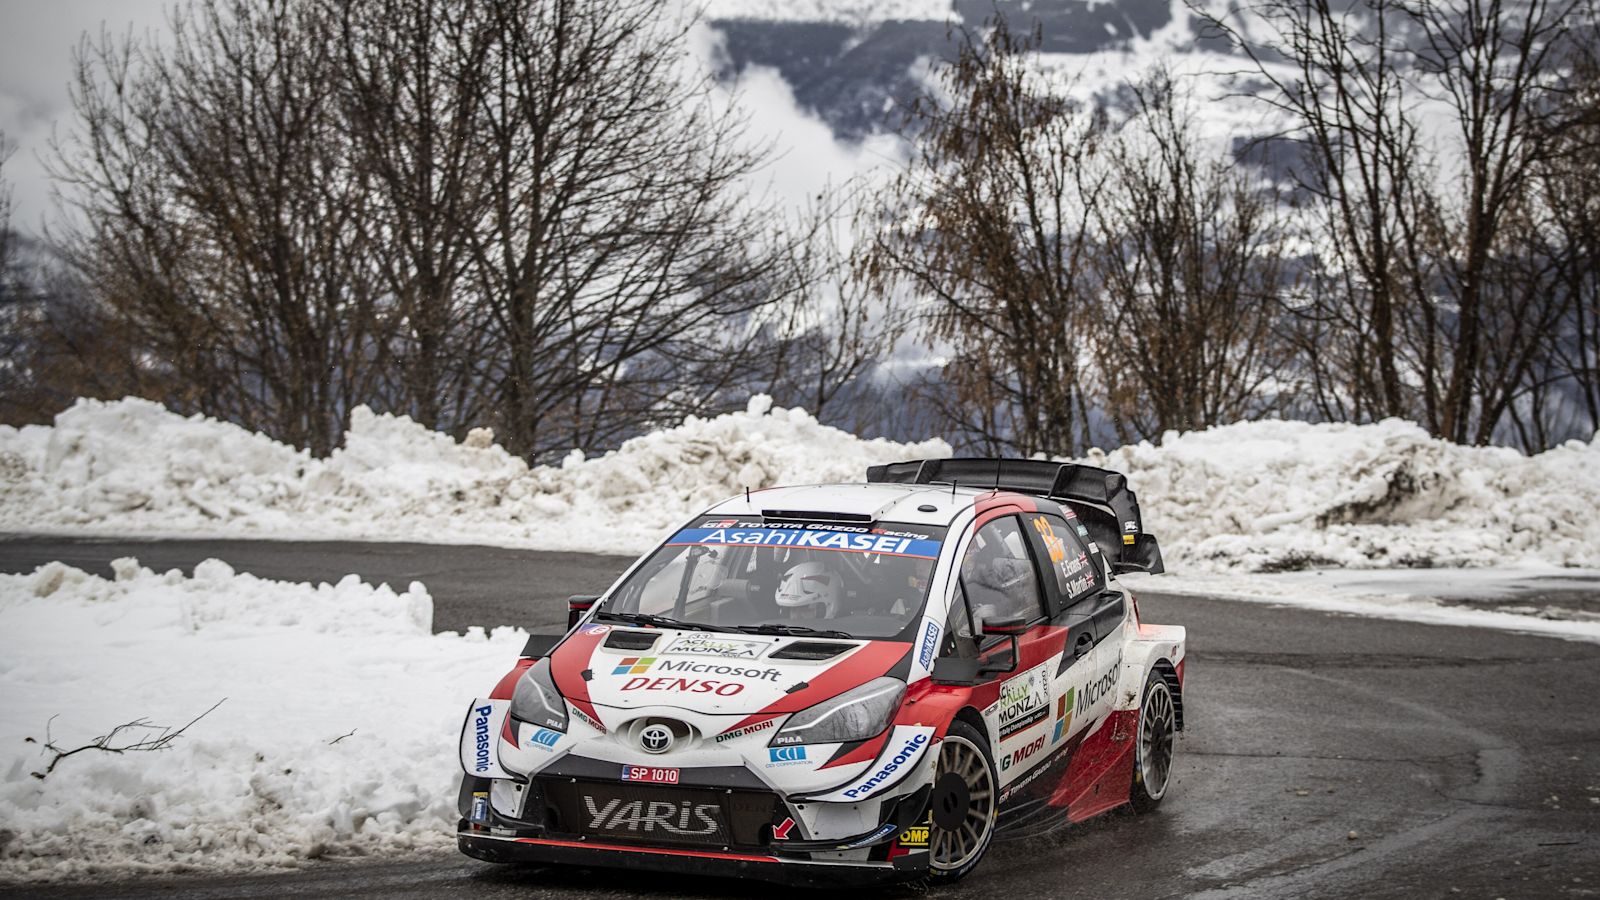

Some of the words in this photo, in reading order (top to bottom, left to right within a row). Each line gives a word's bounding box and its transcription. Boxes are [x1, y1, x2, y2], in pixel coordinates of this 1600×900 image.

[700, 528, 912, 553] AsahiKASEI
[806, 523, 869, 533] GAZOO
[871, 527, 929, 540] Racing
[671, 646, 754, 656] MONZA
[920, 623, 938, 668] AsahiKASEI
[658, 659, 782, 683] Microsoft
[620, 677, 745, 696] DENSO
[999, 691, 1042, 723] MONZA
[571, 707, 588, 722] DMG
[588, 718, 607, 735] MORI
[715, 730, 743, 743] DMG
[743, 720, 774, 735] MORI
[475, 704, 494, 772] Panasonic
[777, 735, 803, 744] PIAA
[1012, 734, 1046, 766] MORI
[631, 767, 648, 780] SP
[651, 768, 677, 782] 1010
[843, 733, 927, 799] Panasonic
[900, 830, 929, 843] OMP
